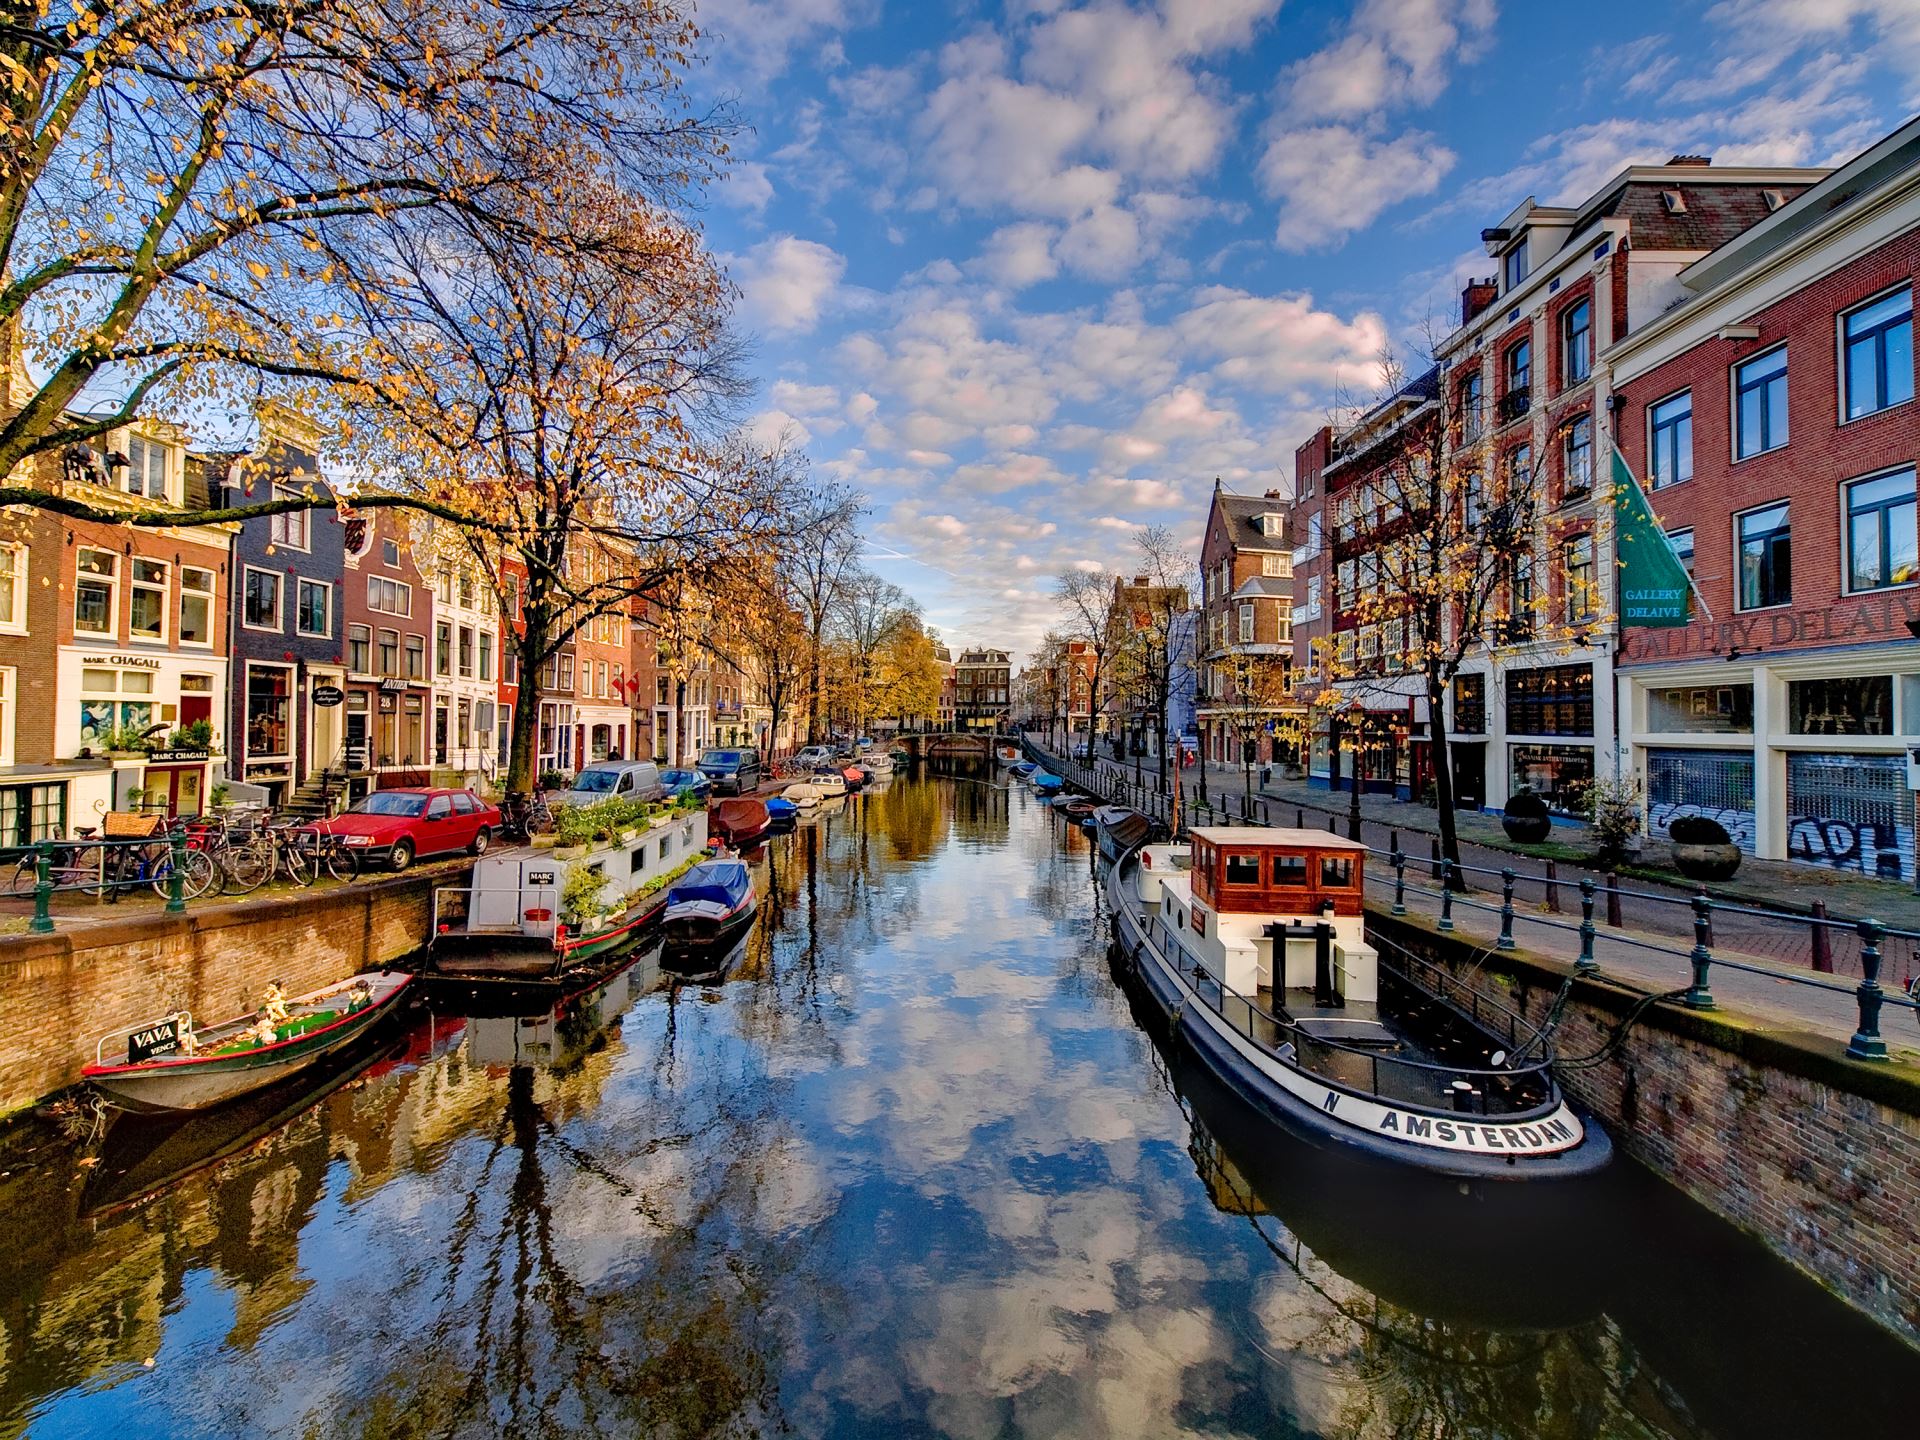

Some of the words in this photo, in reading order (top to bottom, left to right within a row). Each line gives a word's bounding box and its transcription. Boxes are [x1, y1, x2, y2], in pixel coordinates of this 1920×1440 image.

[1625, 589, 1683, 600] GALLERY
[1626, 607, 1681, 618] DELAIVE
[110, 655, 162, 669] CHAGALL
[175, 752, 208, 760] CHAGALL
[133, 1025, 174, 1048] VAVA
[151, 1041, 176, 1055] VENCE
[1380, 1111, 1574, 1148] AMSTERDAM
